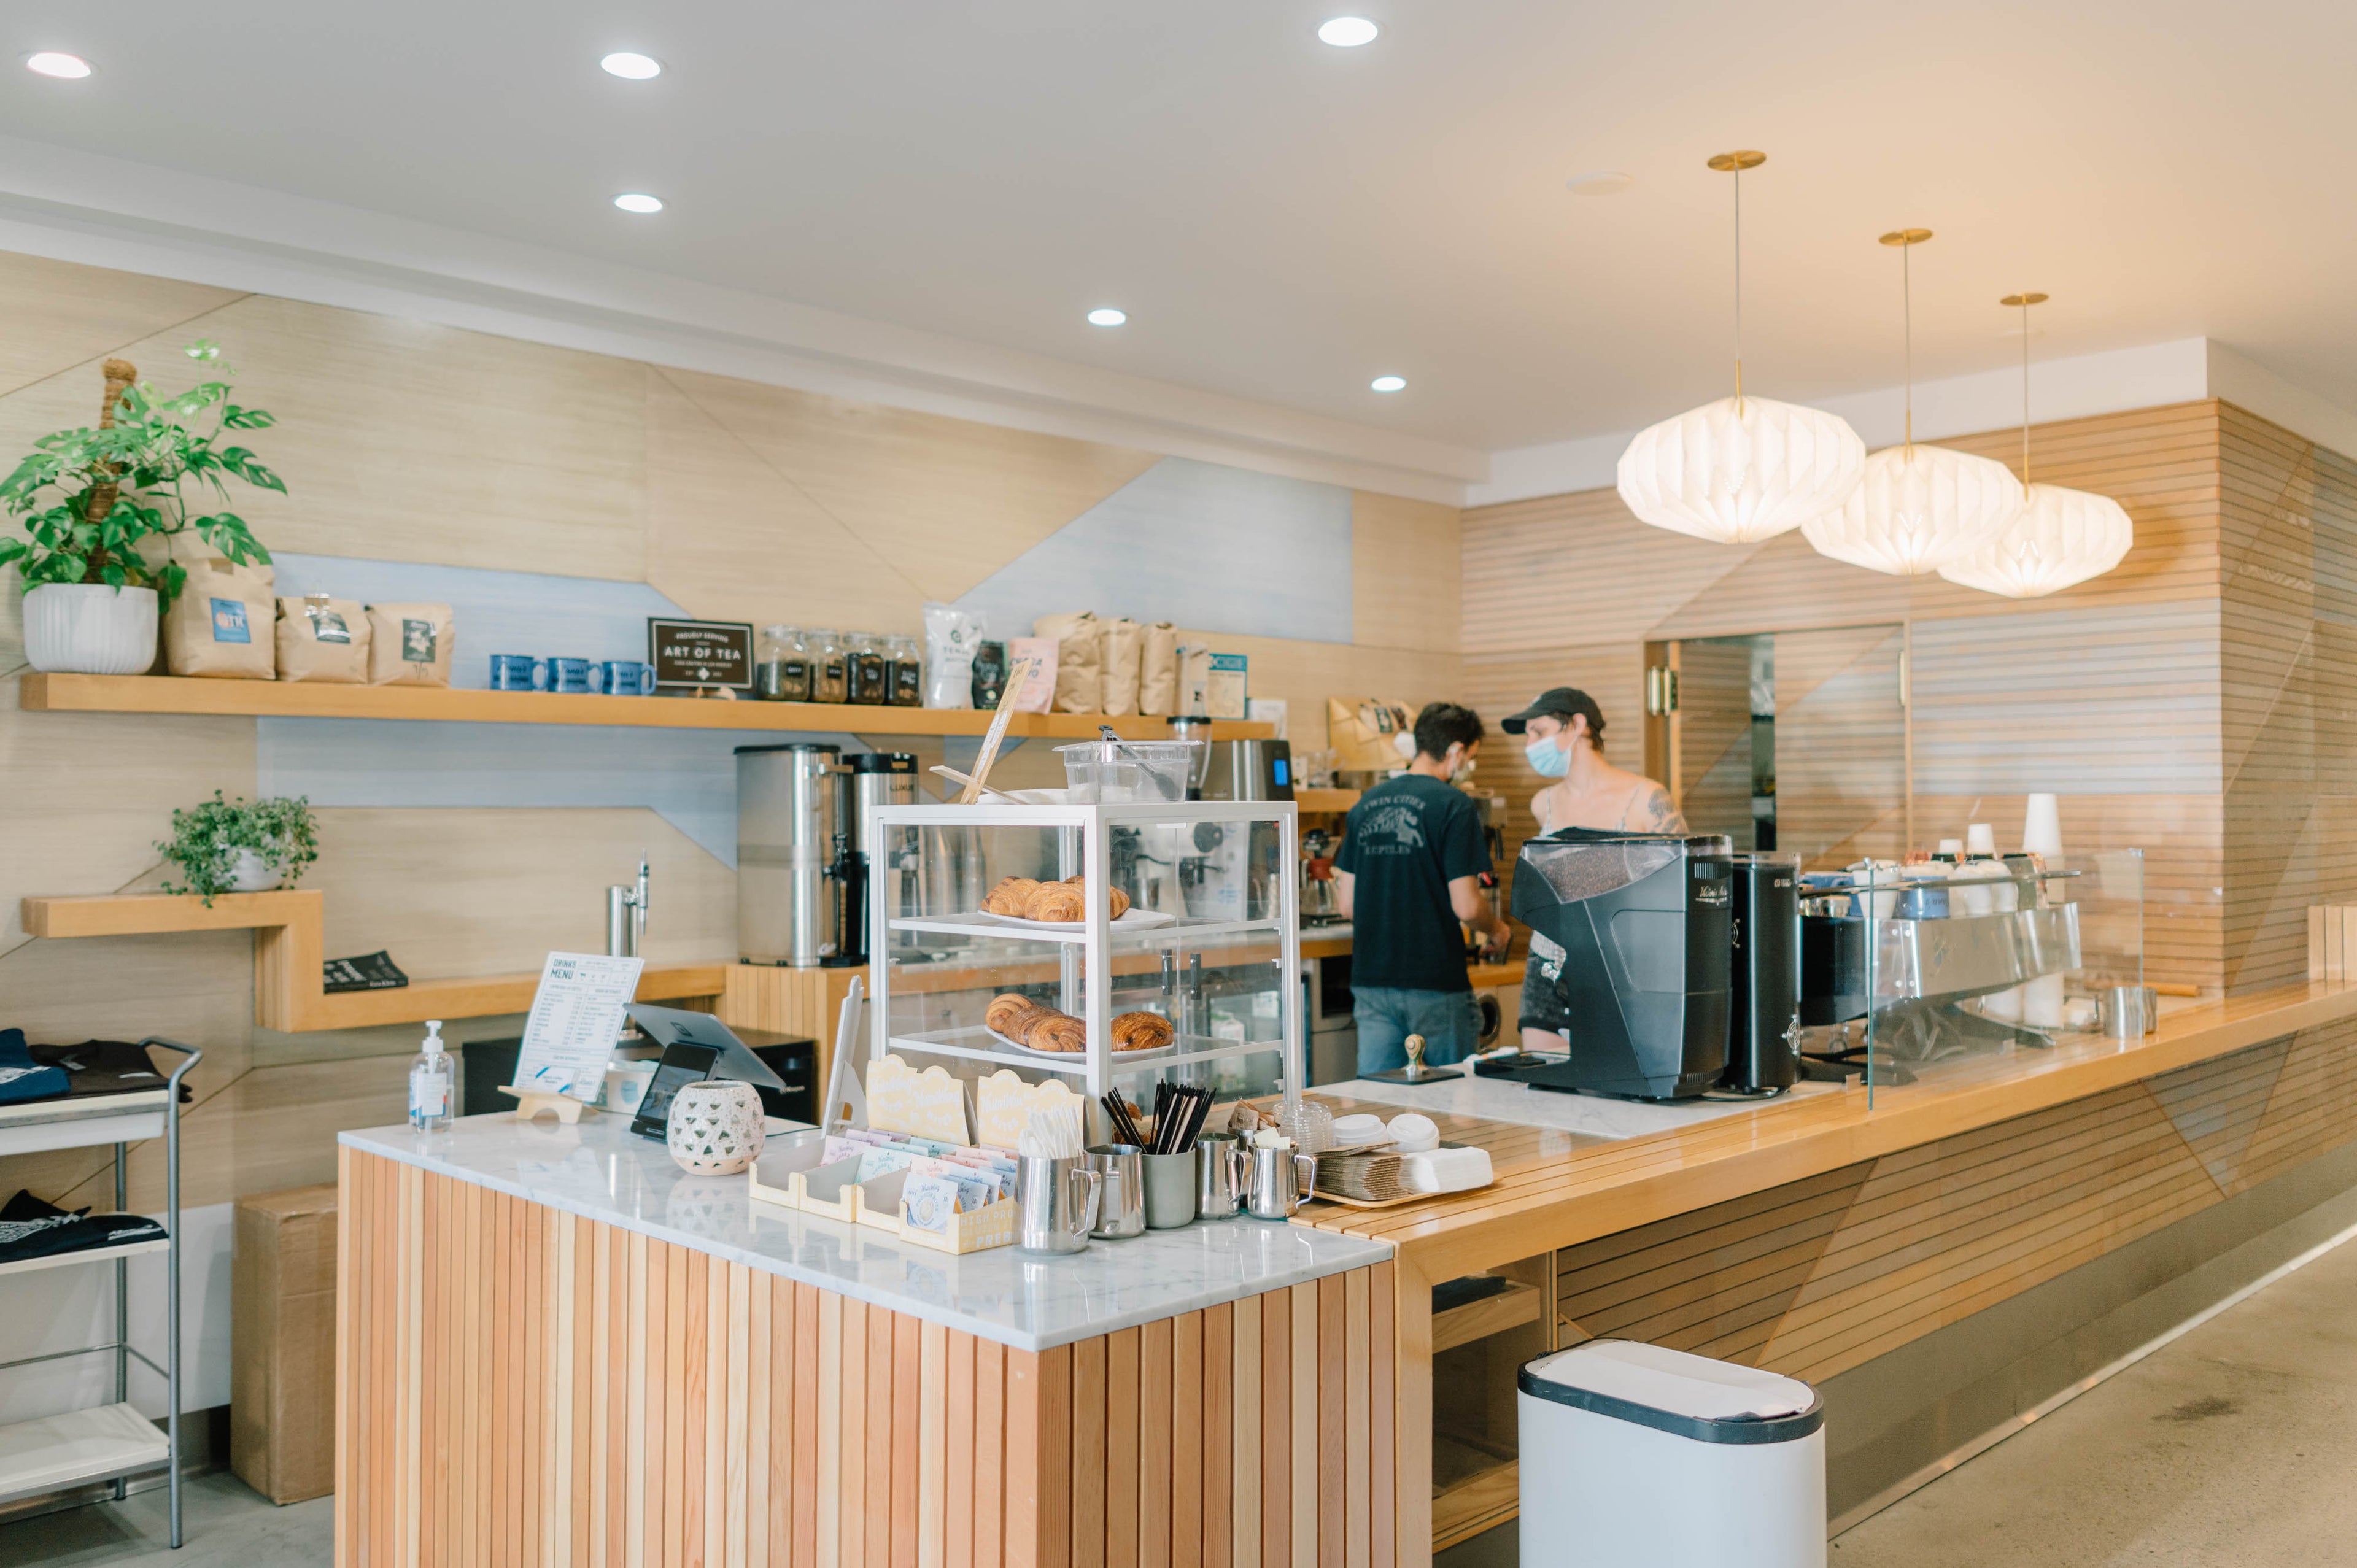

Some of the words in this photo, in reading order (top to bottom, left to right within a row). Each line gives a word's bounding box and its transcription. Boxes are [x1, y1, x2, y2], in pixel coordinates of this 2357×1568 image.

[676, 631, 703, 641] PROUDLY
[705, 632, 729, 643] SERVING
[664, 646, 690, 658] ART
[694, 647, 711, 658] OF
[716, 649, 741, 660] TEA
[1364, 797, 1391, 811] TWIN
[1393, 795, 1425, 809] CITIES
[1365, 845, 1411, 855] REPTILES
[553, 959, 577, 968] DRINKS
[550, 969, 574, 980] MENU
[960, 1213, 989, 1227] HIGH
[993, 1208, 1013, 1221] PRO
[976, 1230, 1012, 1249] PREB
